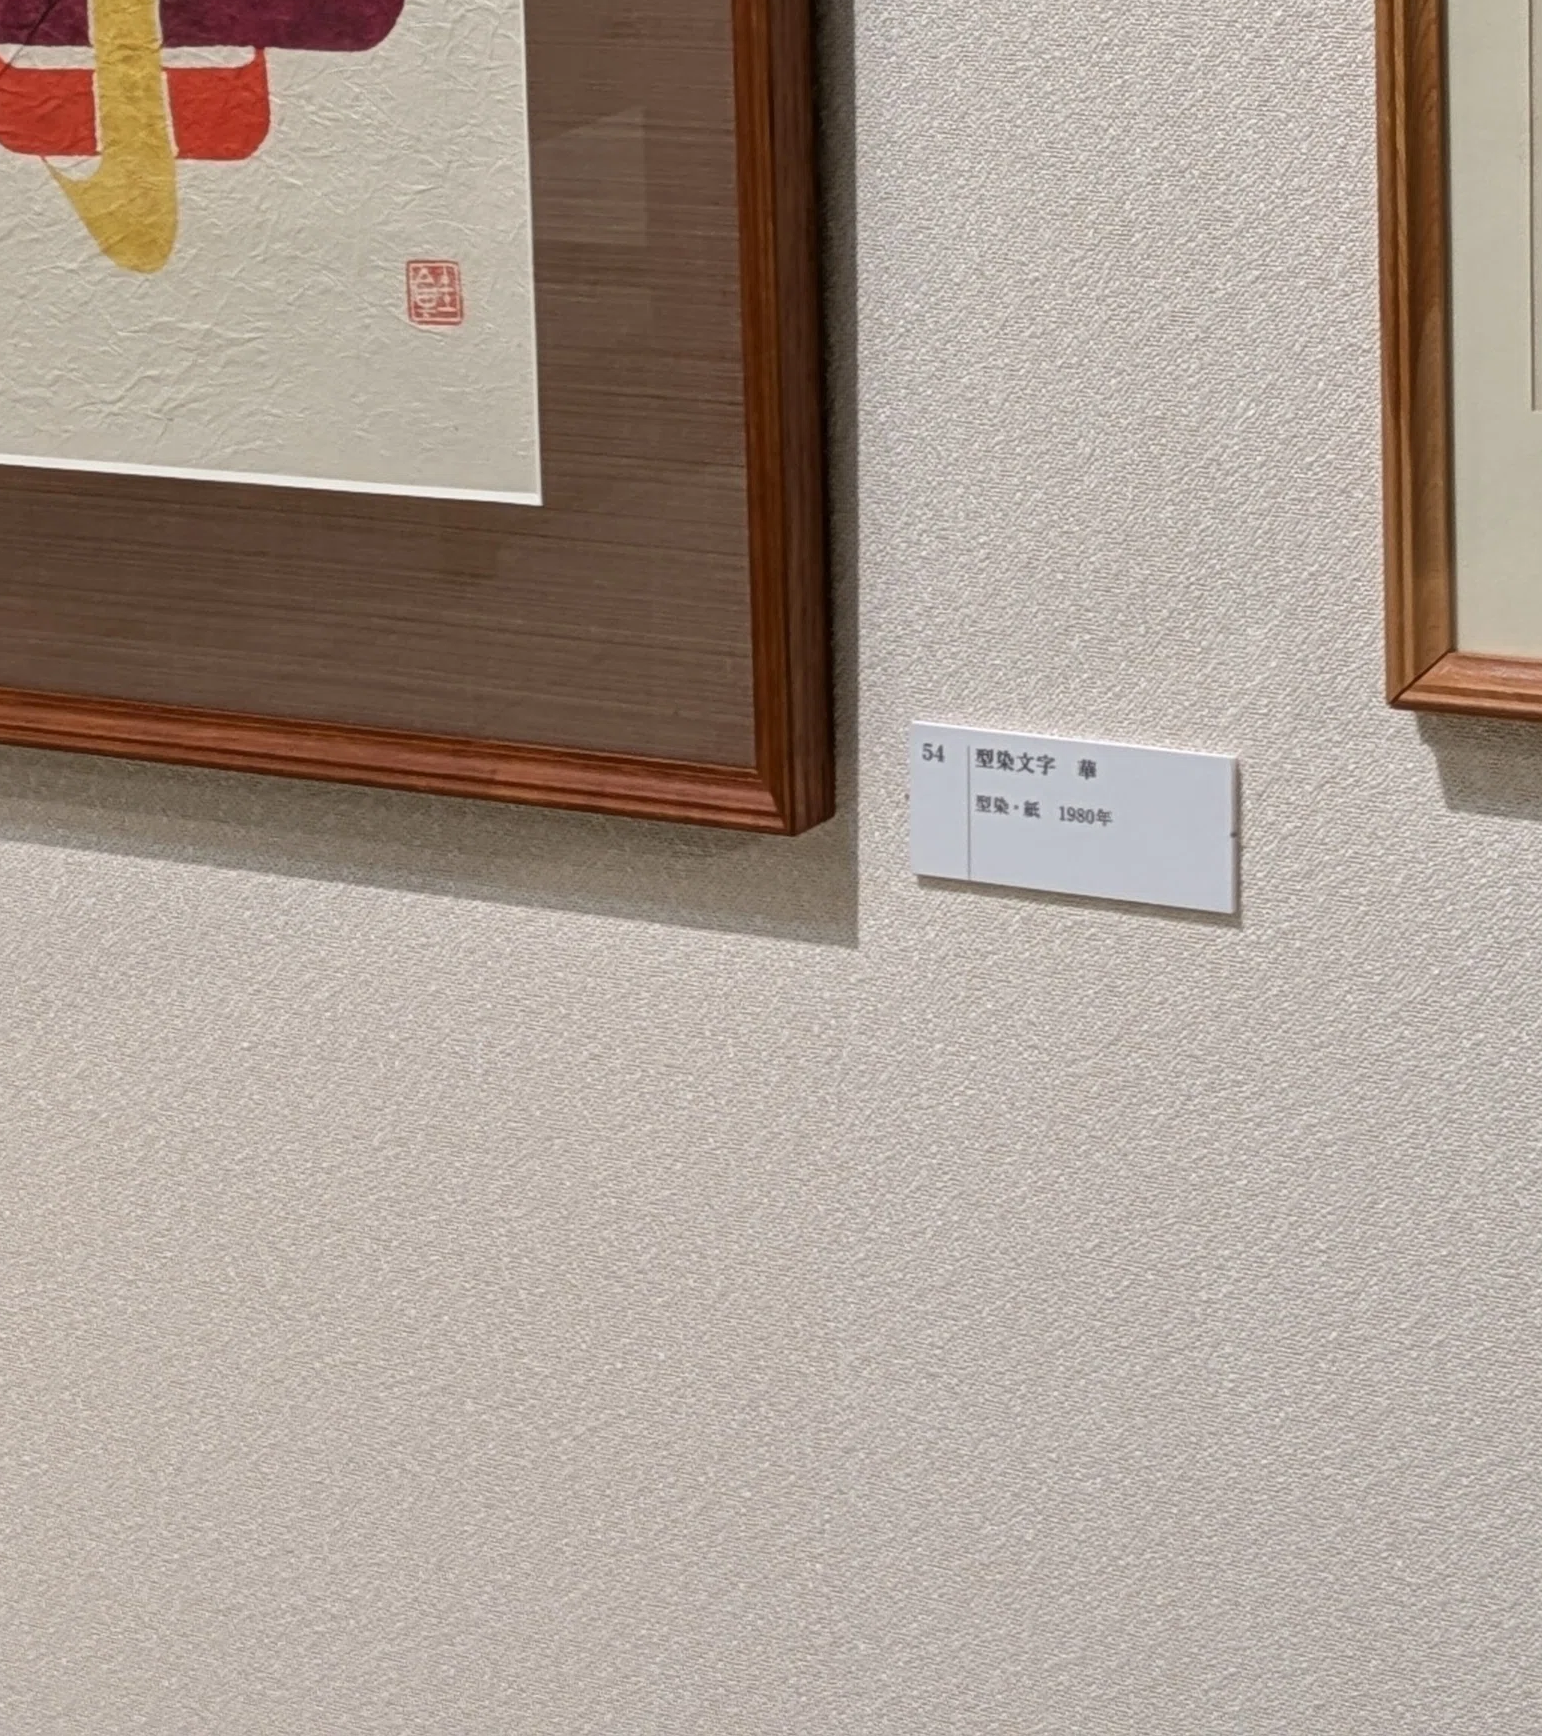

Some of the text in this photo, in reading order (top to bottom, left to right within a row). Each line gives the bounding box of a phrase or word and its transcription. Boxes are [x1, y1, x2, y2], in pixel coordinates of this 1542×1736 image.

[922, 743, 945, 763] 54
[975, 748, 1097, 780] 型染文字 華
[1059, 805, 1114, 827] 1980年
